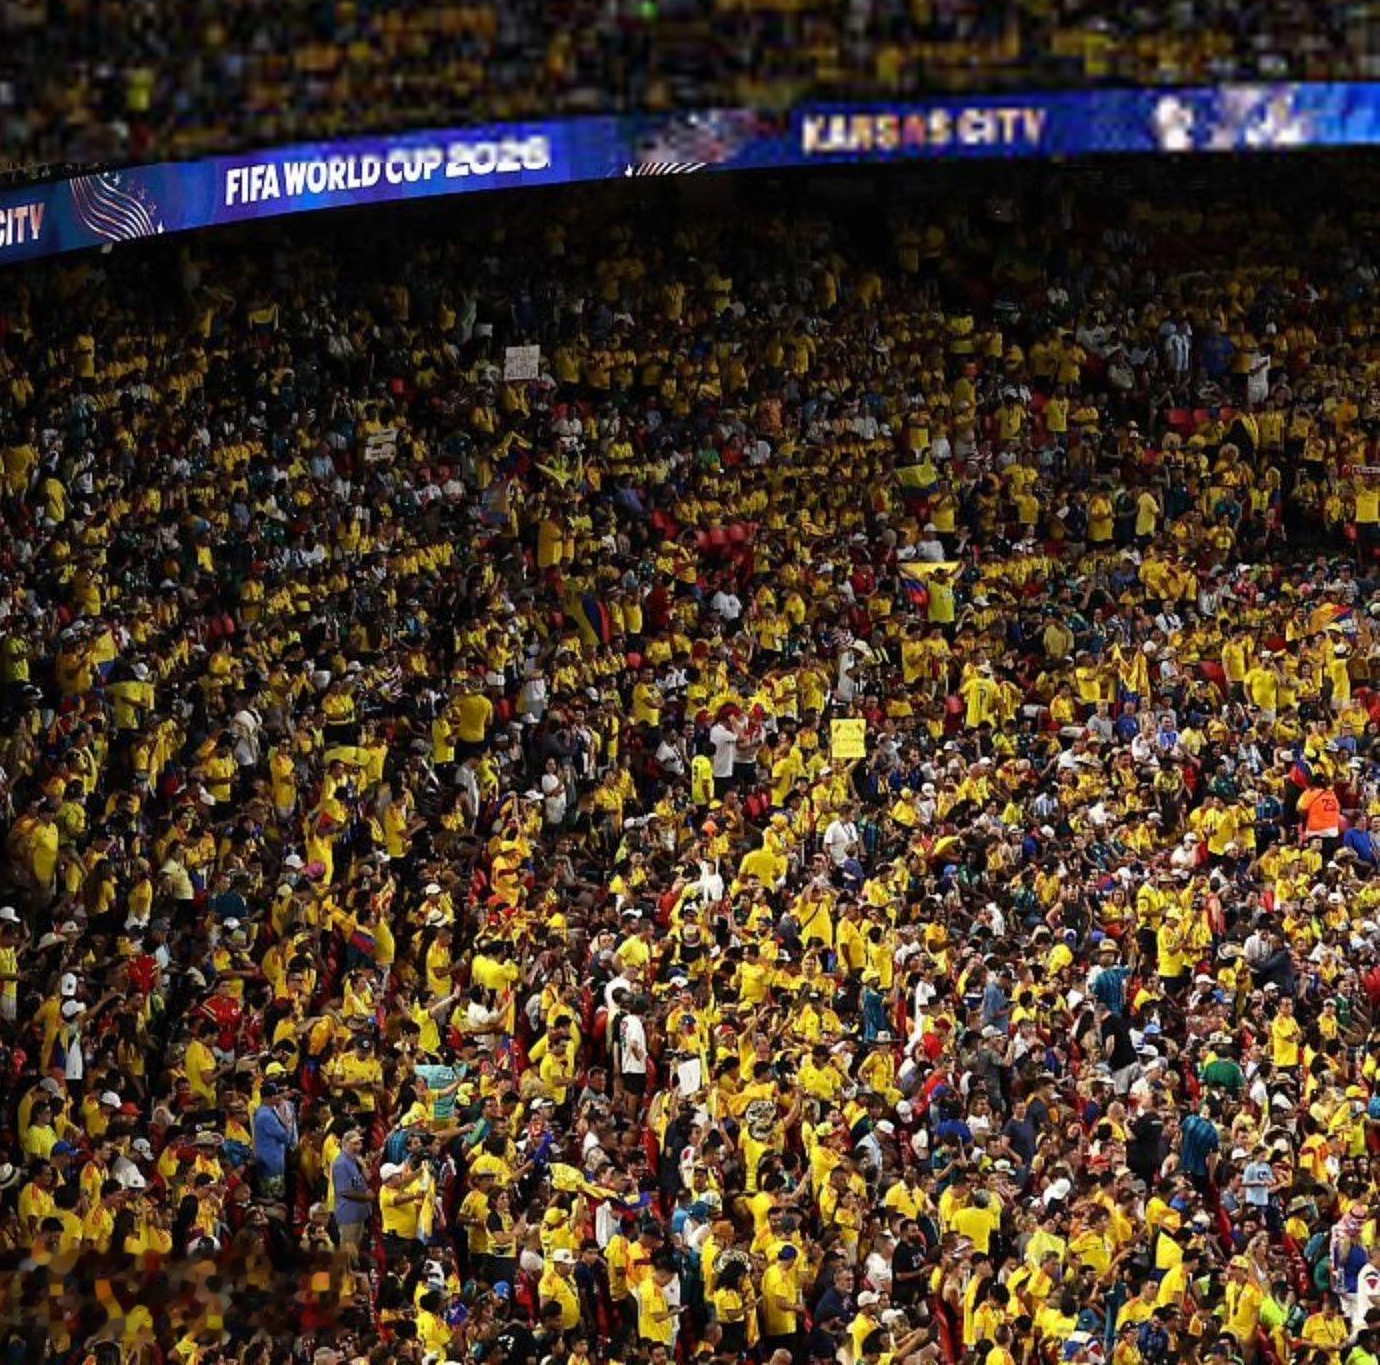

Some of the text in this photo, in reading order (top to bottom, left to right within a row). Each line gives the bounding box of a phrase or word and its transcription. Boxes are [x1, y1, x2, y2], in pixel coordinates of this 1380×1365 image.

[957, 106, 1048, 147] CITY
[225, 164, 280, 206] FIFA
[282, 153, 381, 196] WORLD
[384, 146, 444, 184] CUP
